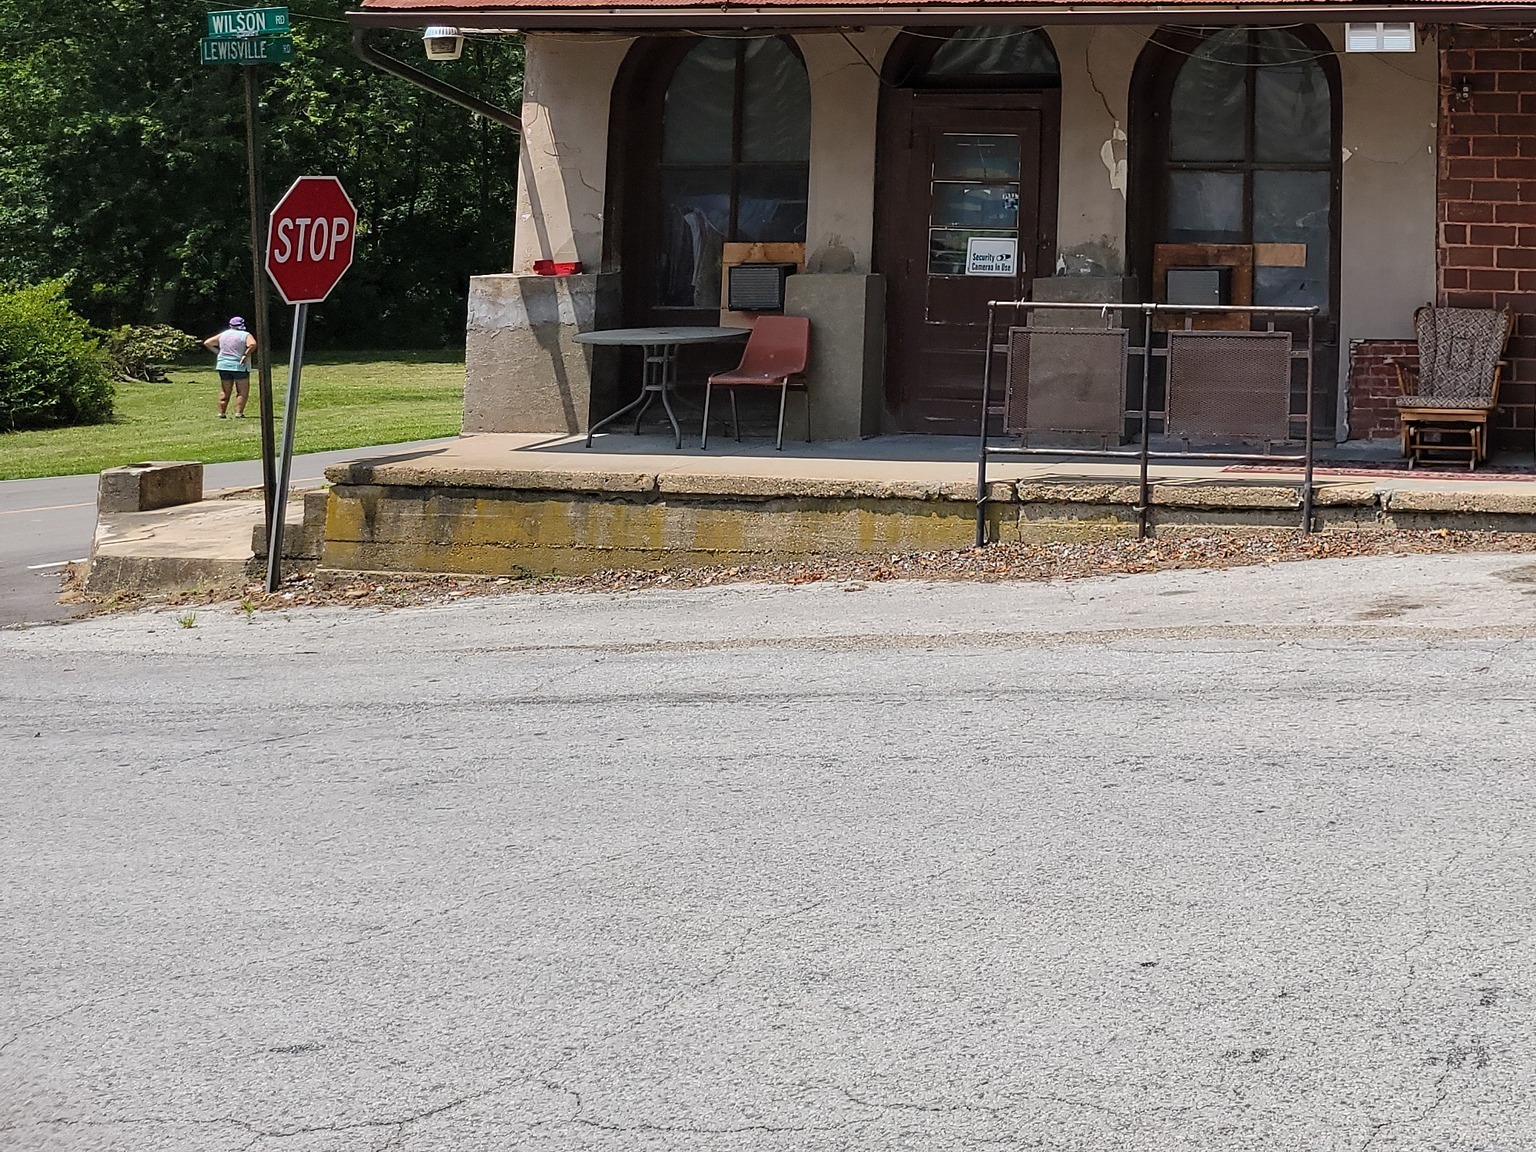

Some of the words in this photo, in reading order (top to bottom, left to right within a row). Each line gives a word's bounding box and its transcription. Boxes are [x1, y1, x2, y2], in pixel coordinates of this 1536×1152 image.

[212, 12, 266, 34] WILSON
[275, 14, 285, 25] RD
[204, 40, 268, 60] LEWISVILLE
[274, 217, 350, 264] STOP
[971, 262, 994, 271] Cameras
[1001, 263, 1011, 271] Use
[972, 252, 995, 263] Security
